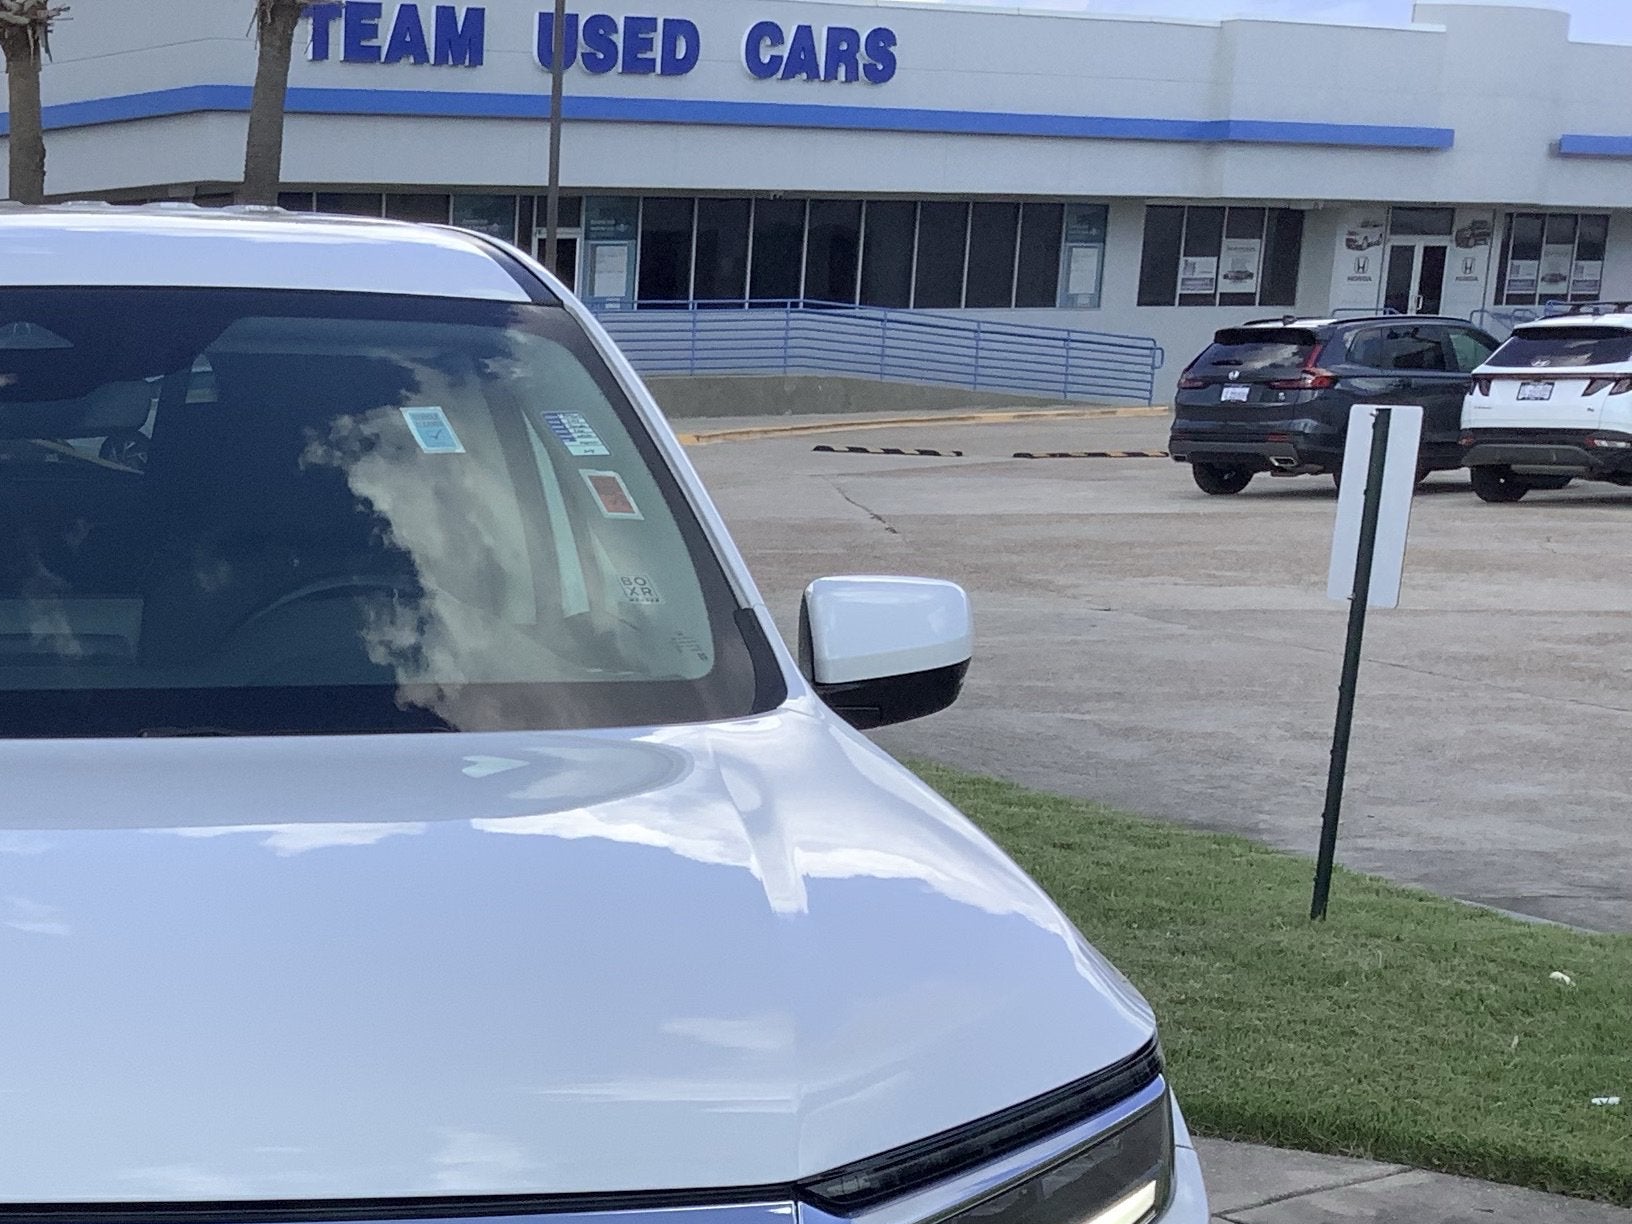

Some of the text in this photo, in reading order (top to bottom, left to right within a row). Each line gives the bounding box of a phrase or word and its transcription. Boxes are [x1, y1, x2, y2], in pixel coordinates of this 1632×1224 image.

[304, 0, 899, 85] TEAM USED CARS
